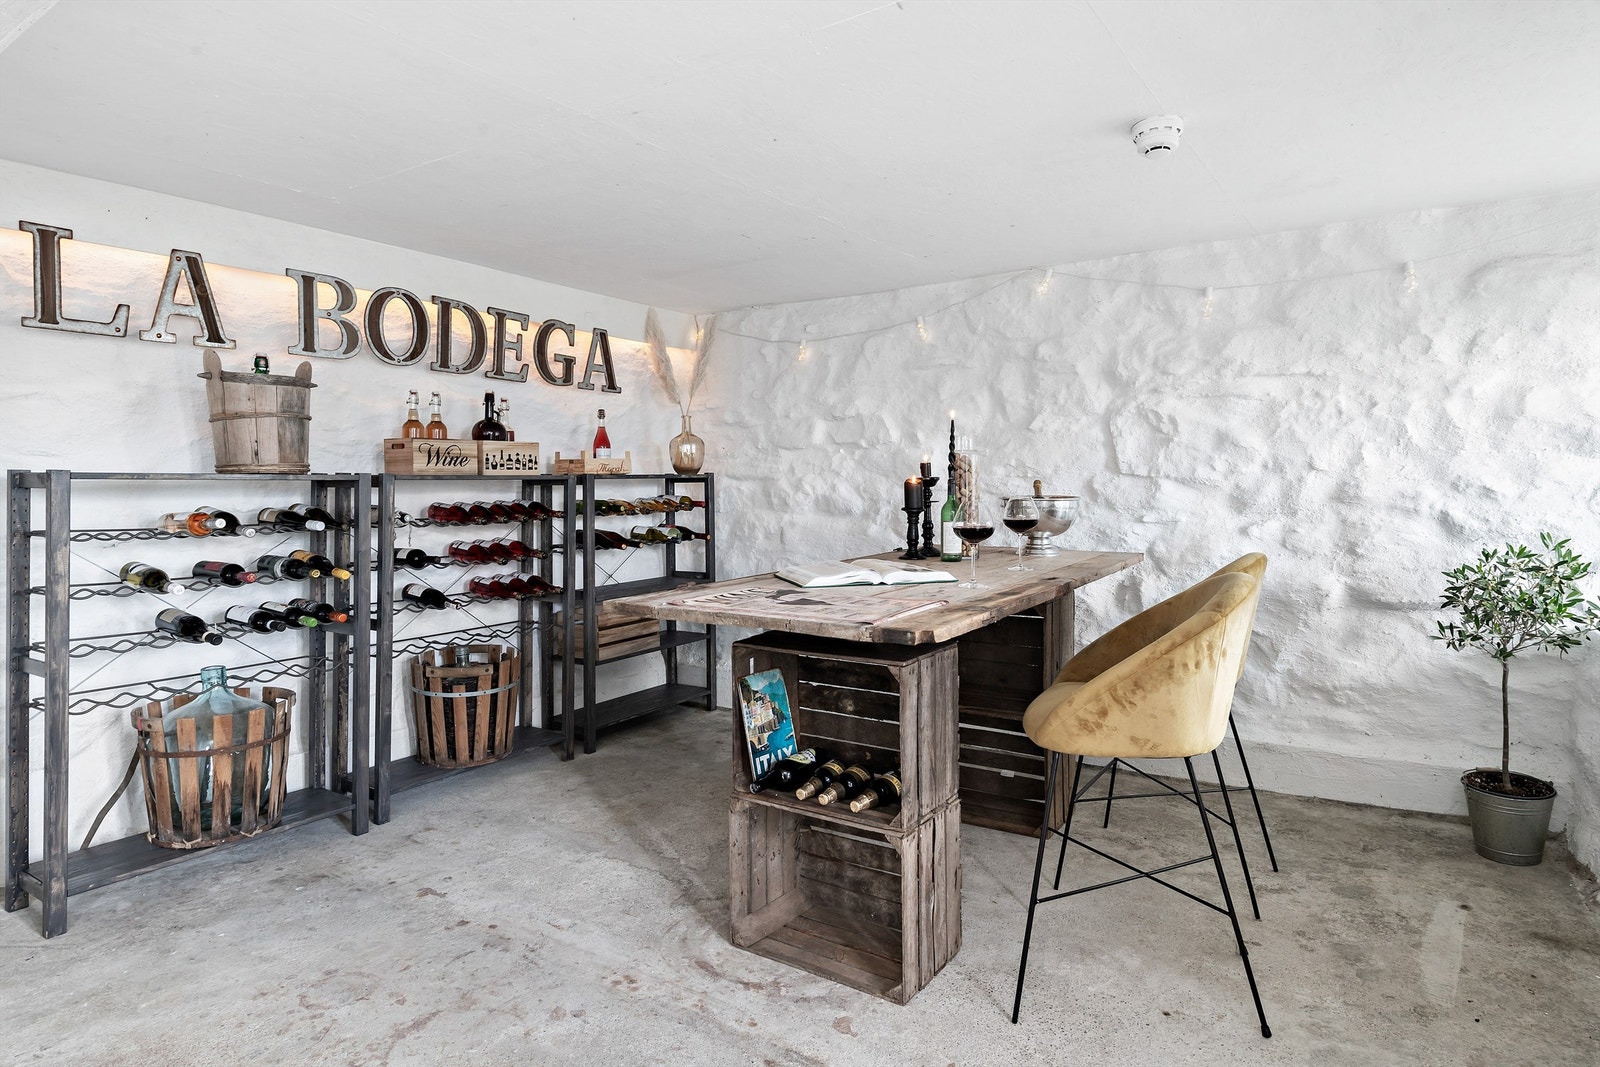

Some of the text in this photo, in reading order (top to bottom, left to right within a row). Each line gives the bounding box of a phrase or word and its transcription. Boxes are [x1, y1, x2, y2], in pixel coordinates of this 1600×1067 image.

[19, 220, 622, 394] LA BODEGA
[418, 442, 471, 467] Wine
